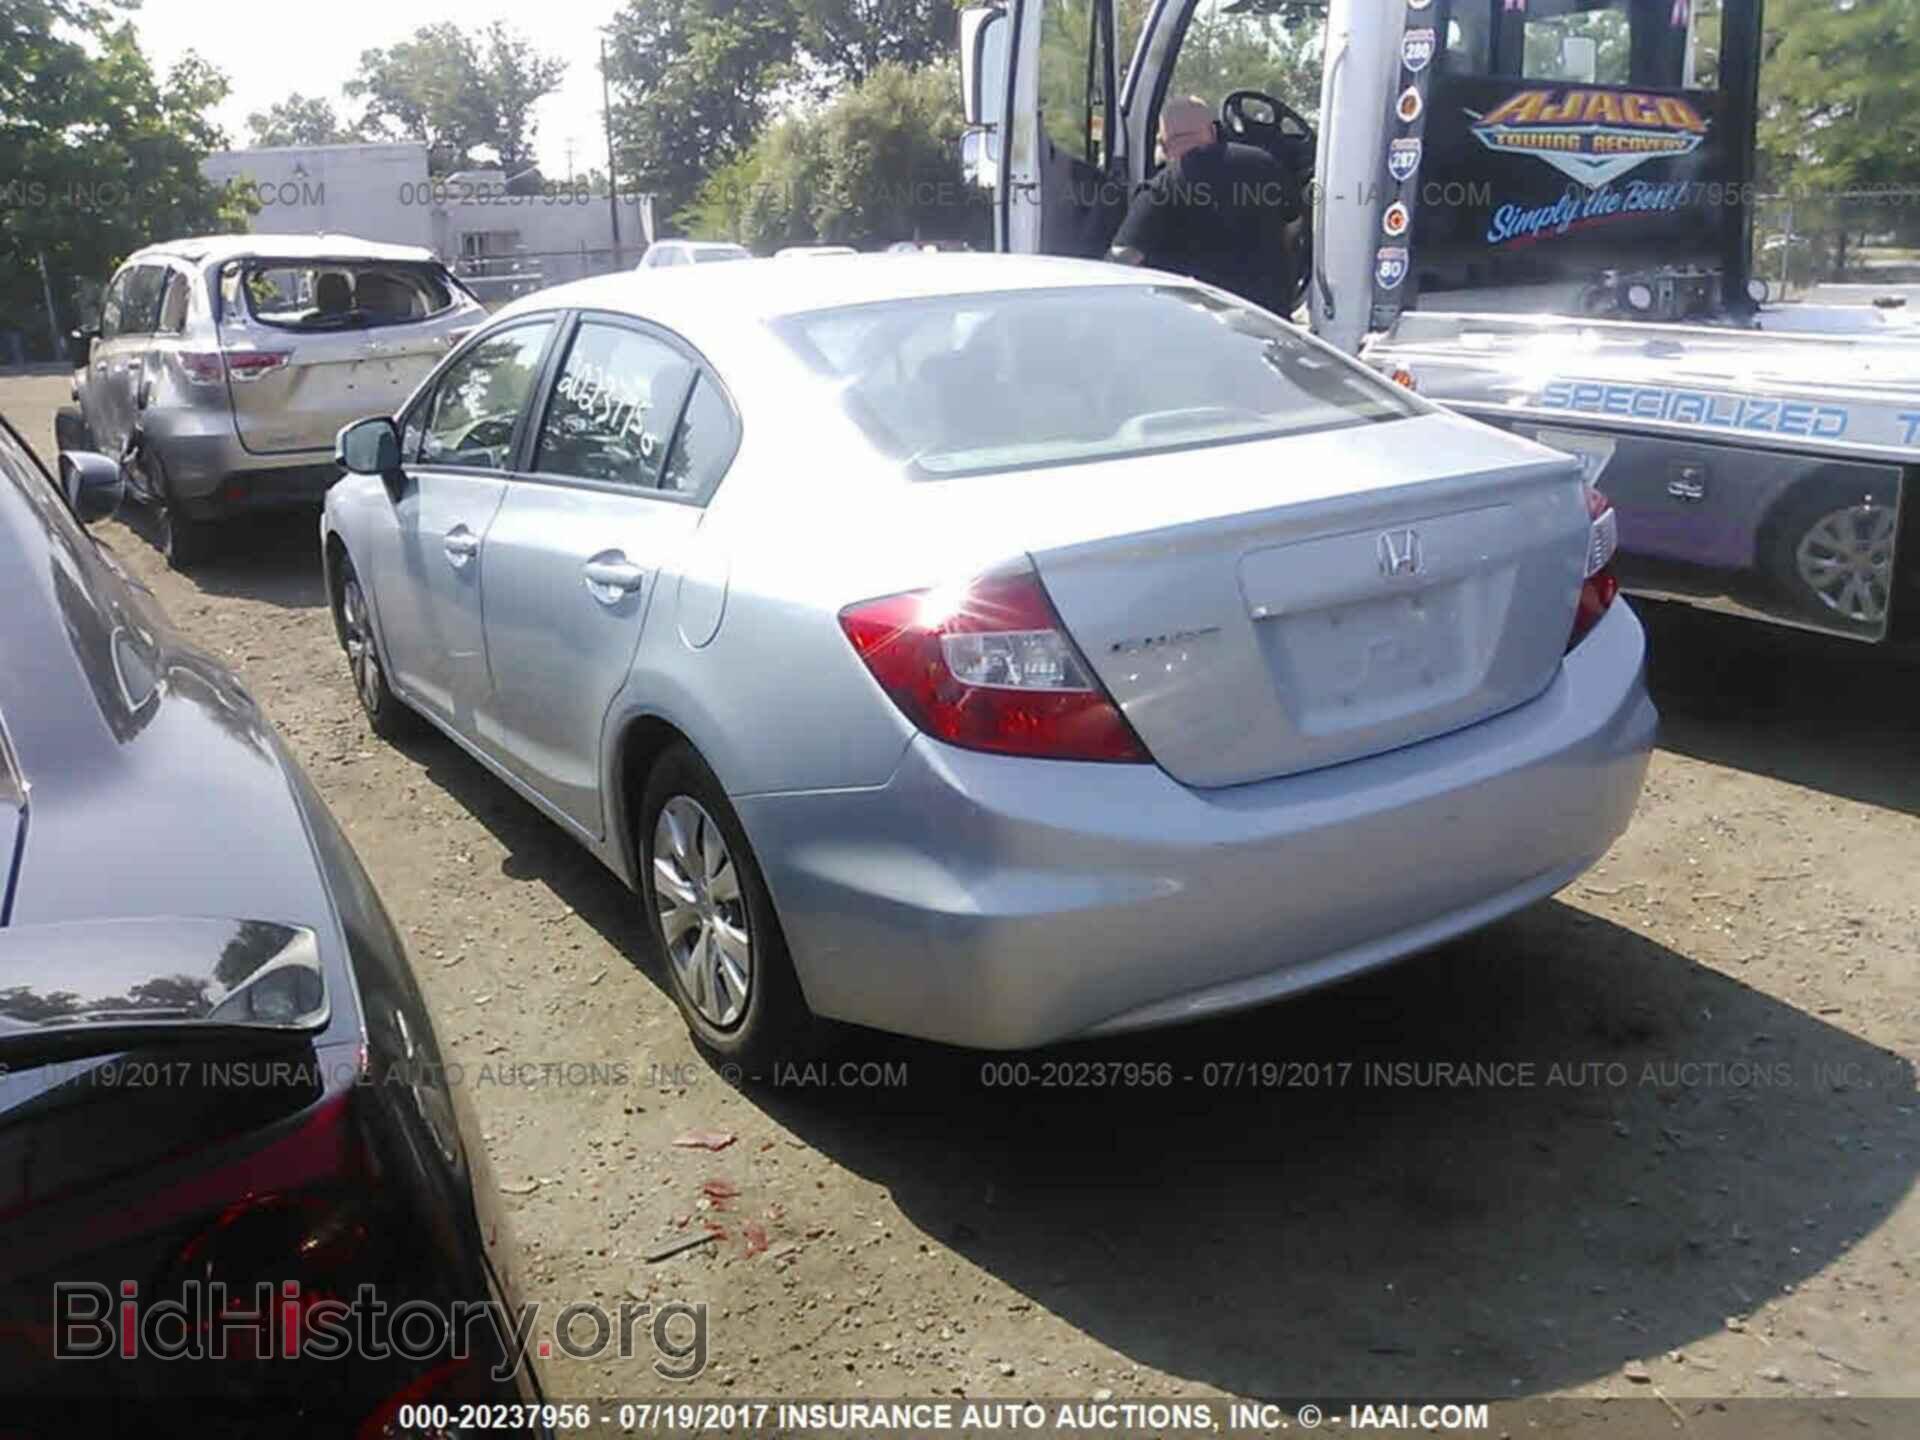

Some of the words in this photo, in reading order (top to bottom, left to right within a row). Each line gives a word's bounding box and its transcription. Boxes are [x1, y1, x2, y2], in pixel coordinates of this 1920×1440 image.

[1406, 42, 1430, 59] 280
[1494, 133, 1581, 150] TOWING
[1592, 134, 1687, 152] RECOVERY
[1487, 192, 1579, 242] Simply
[1583, 188, 1616, 217] the
[1380, 261, 1401, 278] 80
[1543, 381, 1848, 439] SPECIALIZED
